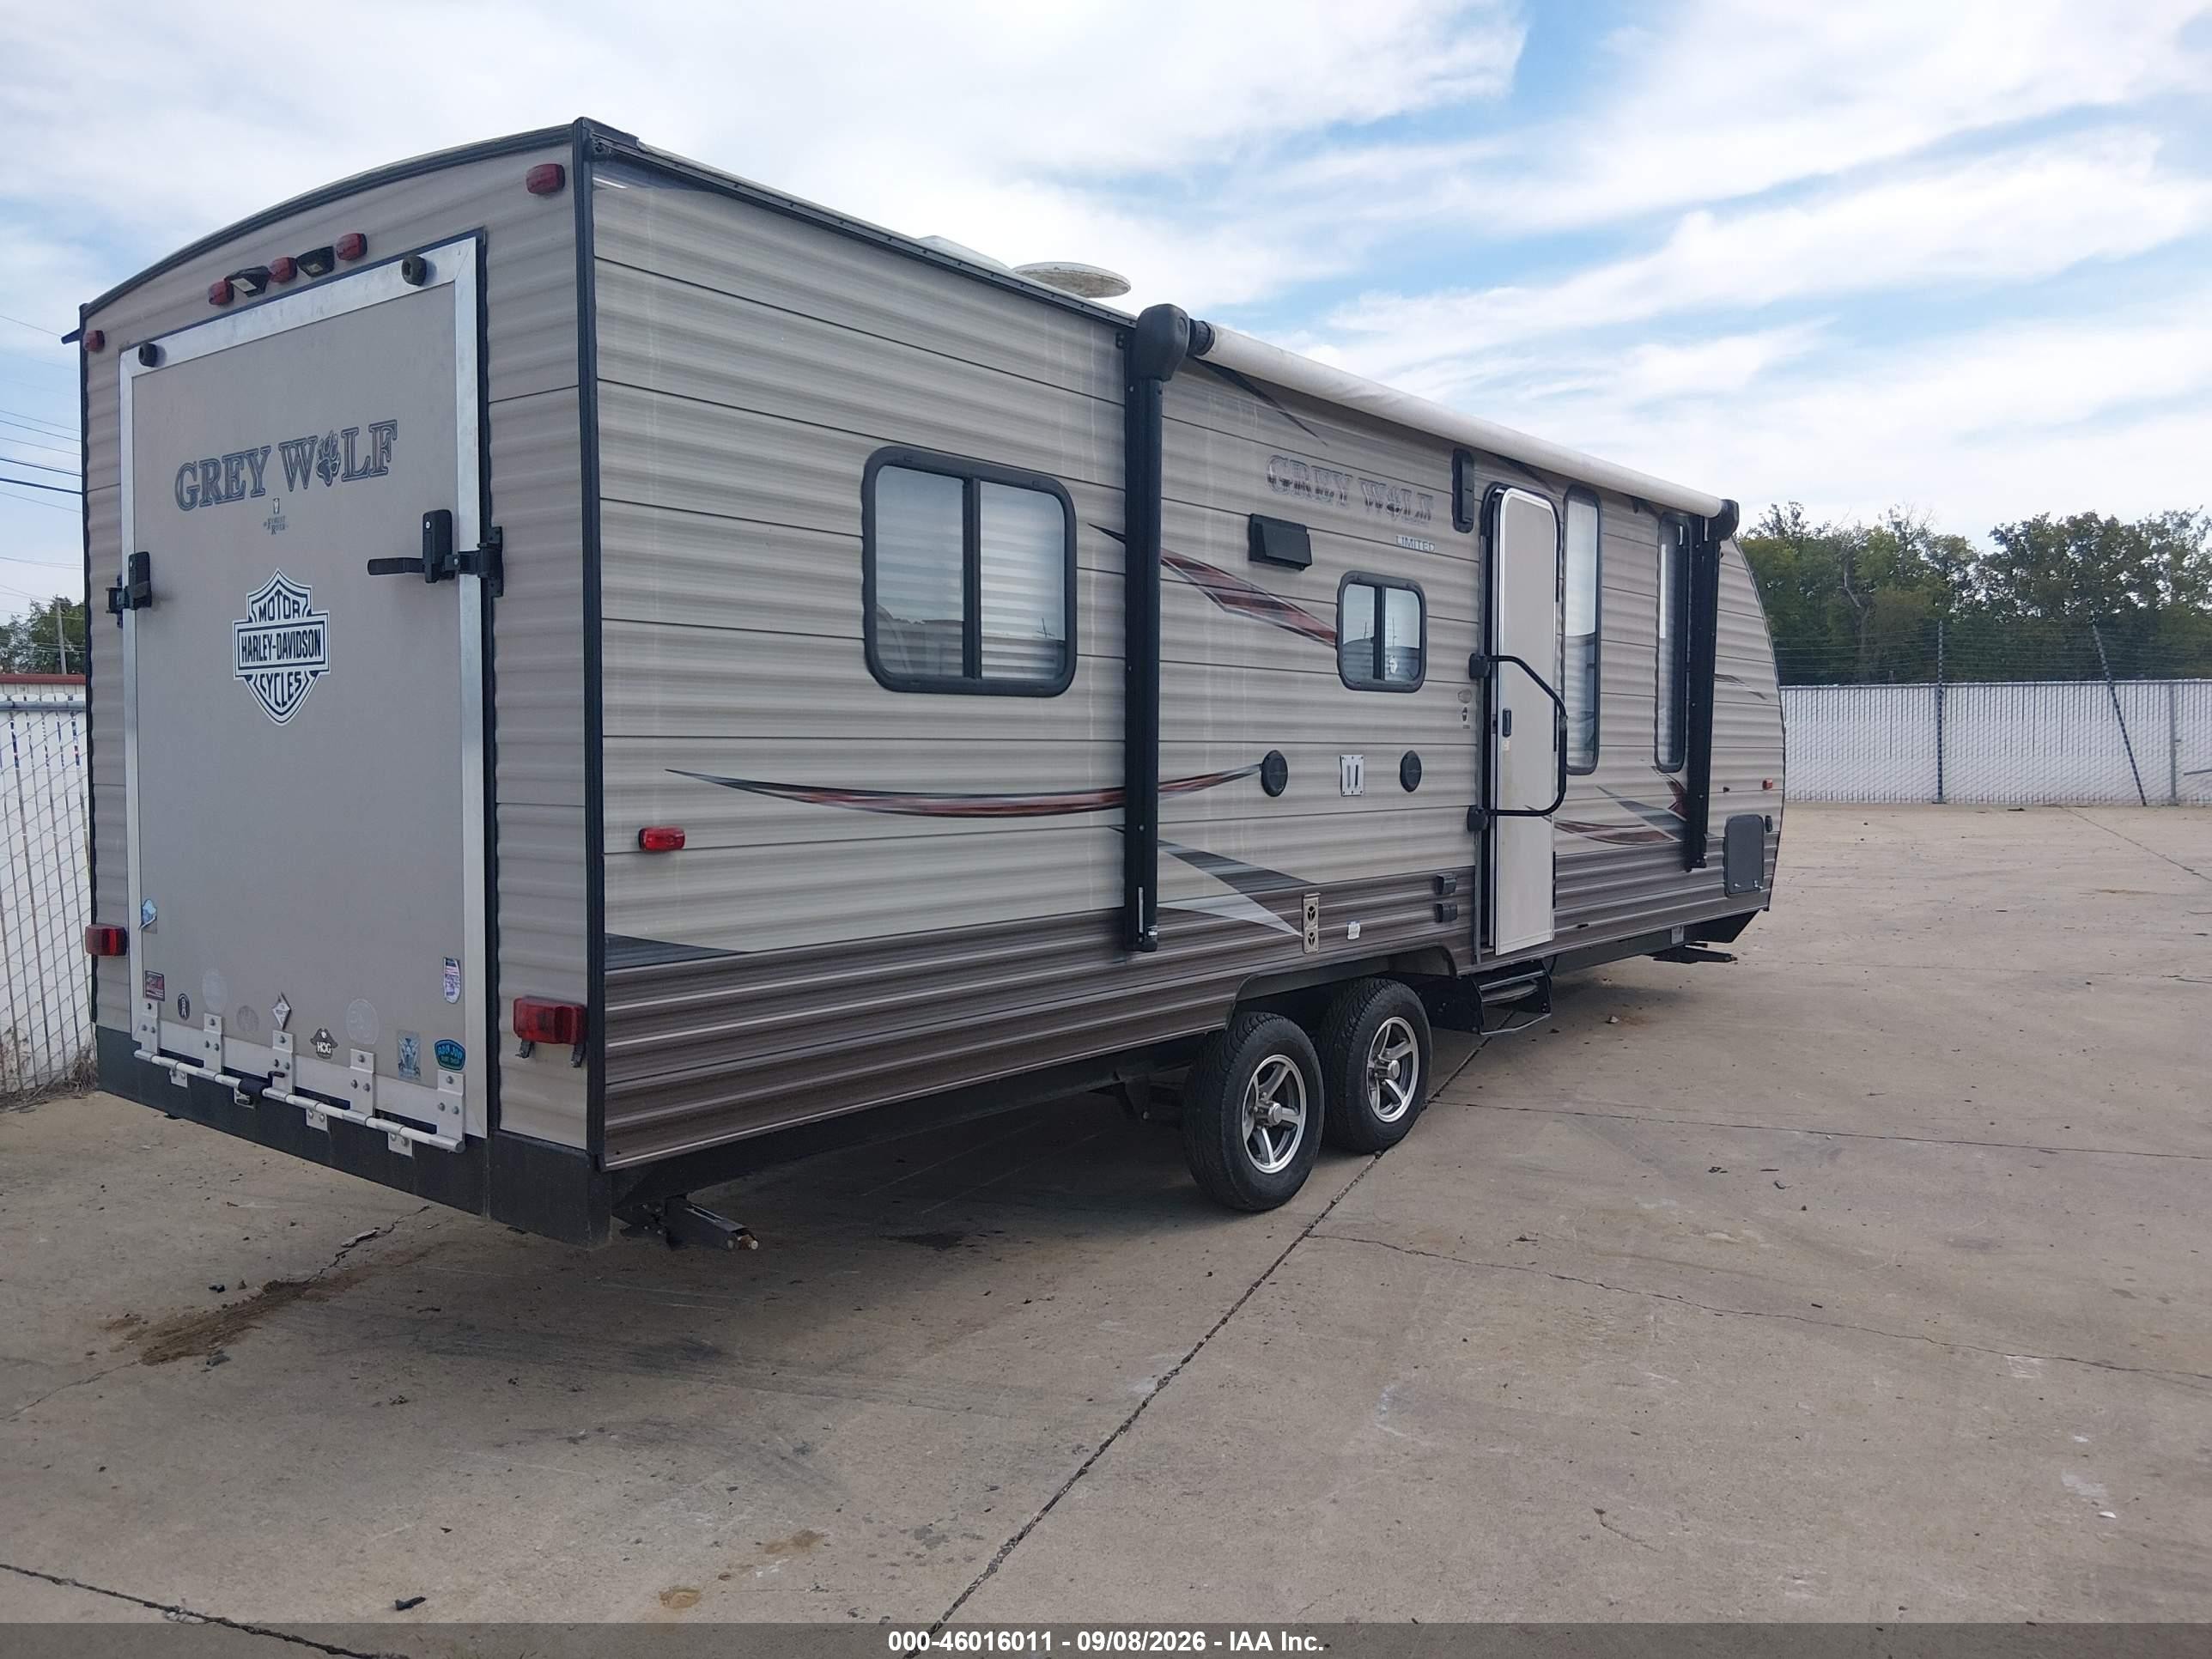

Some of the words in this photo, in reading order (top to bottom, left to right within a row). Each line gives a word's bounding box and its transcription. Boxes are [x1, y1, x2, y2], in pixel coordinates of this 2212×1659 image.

[174, 445, 271, 511] GREY
[1267, 454, 1354, 507] GREY
[1395, 535, 1436, 552] LIMITED
[258, 589, 301, 623] MOTOR
[241, 629, 321, 663] HARLEY-DAVIDSON
[259, 671, 302, 708] CYCLES
[317, 1042, 331, 1054] HOG
